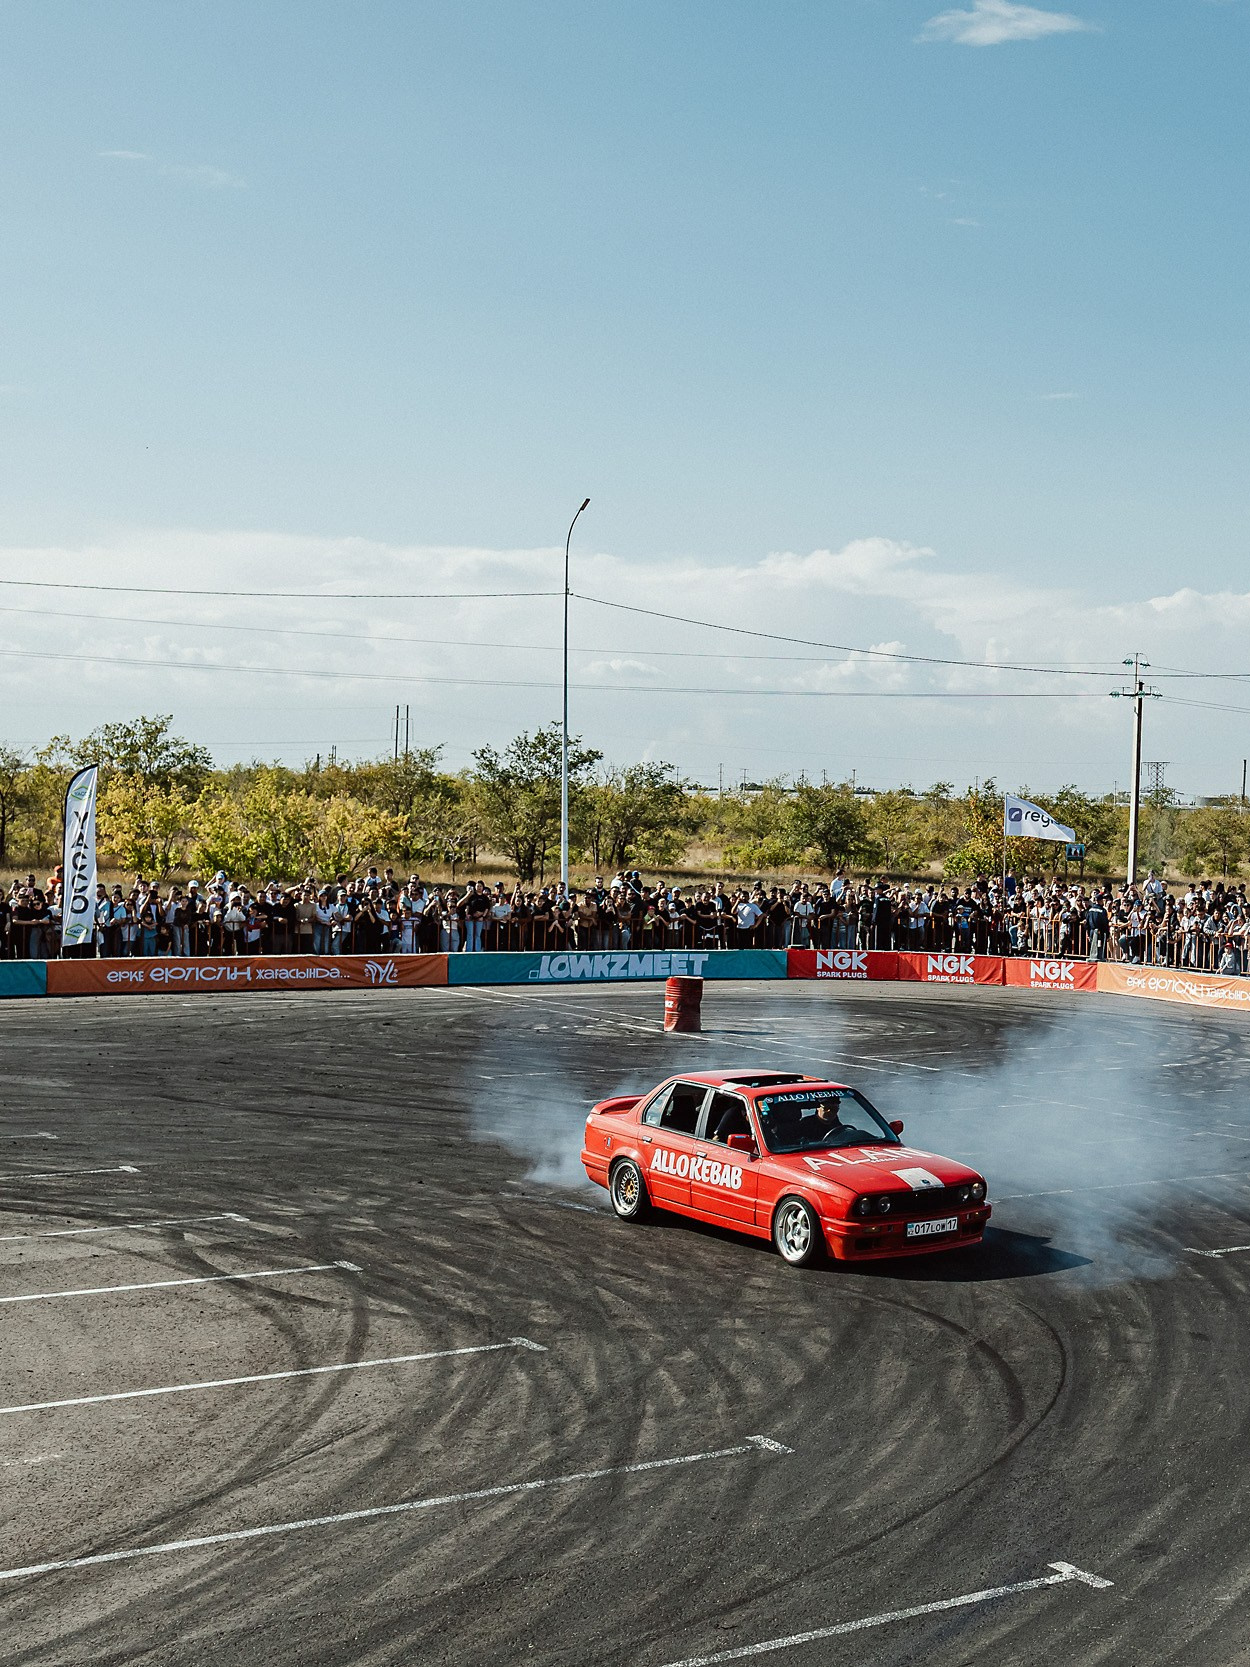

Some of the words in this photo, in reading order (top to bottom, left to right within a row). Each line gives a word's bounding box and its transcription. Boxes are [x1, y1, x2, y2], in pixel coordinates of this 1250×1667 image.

[71, 811, 89, 914] YACCO
[538, 953, 709, 979] LOWKZMEET
[816, 951, 868, 971] NGK
[927, 955, 975, 975] NGK
[842, 971, 868, 979] PLUGS
[927, 974, 950, 982] SPARK
[951, 975, 975, 983] PLUGS
[1030, 960, 1075, 981] NGK
[1052, 982, 1075, 990] PLUGS
[778, 1093, 804, 1102] ALLO
[810, 1090, 845, 1099] KEBAB
[947, 1218, 957, 1230] 17
